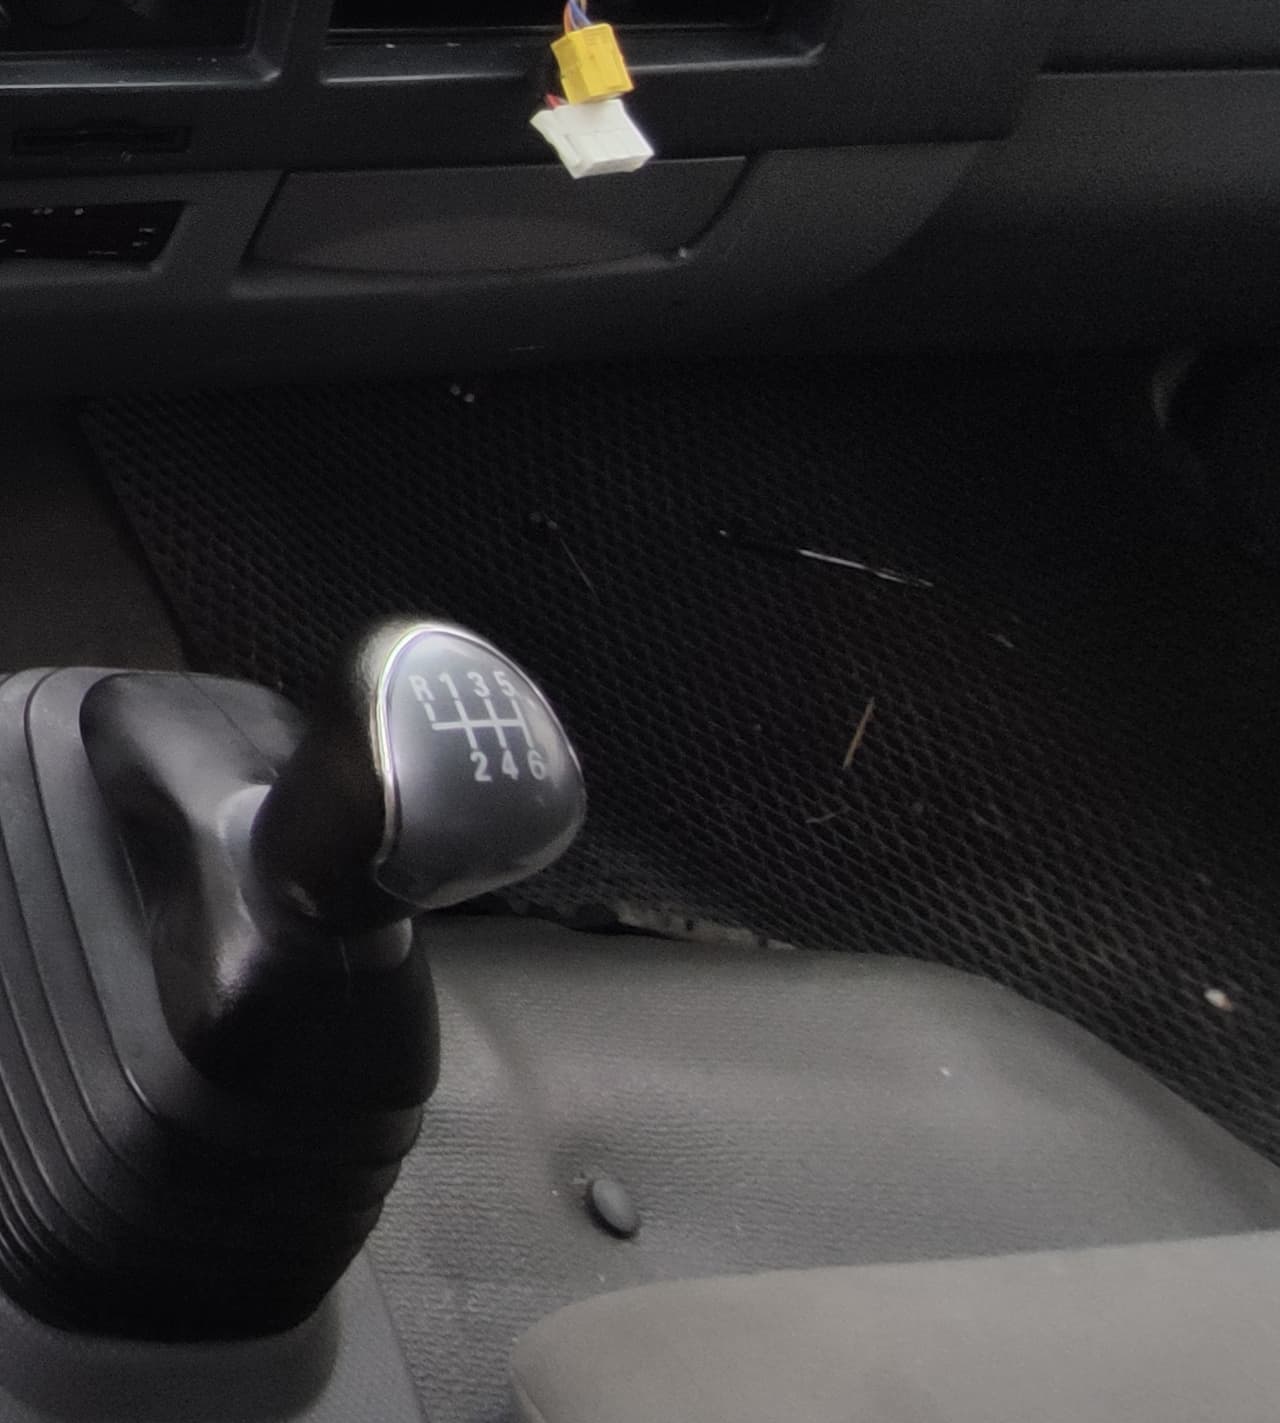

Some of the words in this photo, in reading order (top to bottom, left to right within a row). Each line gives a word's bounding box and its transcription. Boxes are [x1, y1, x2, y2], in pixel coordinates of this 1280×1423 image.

[408, 674, 436, 701] R
[466, 671, 491, 698] 3
[493, 671, 517, 697] 5
[469, 750, 493, 782] 2
[501, 749, 520, 780] 4
[526, 750, 546, 781] 6
